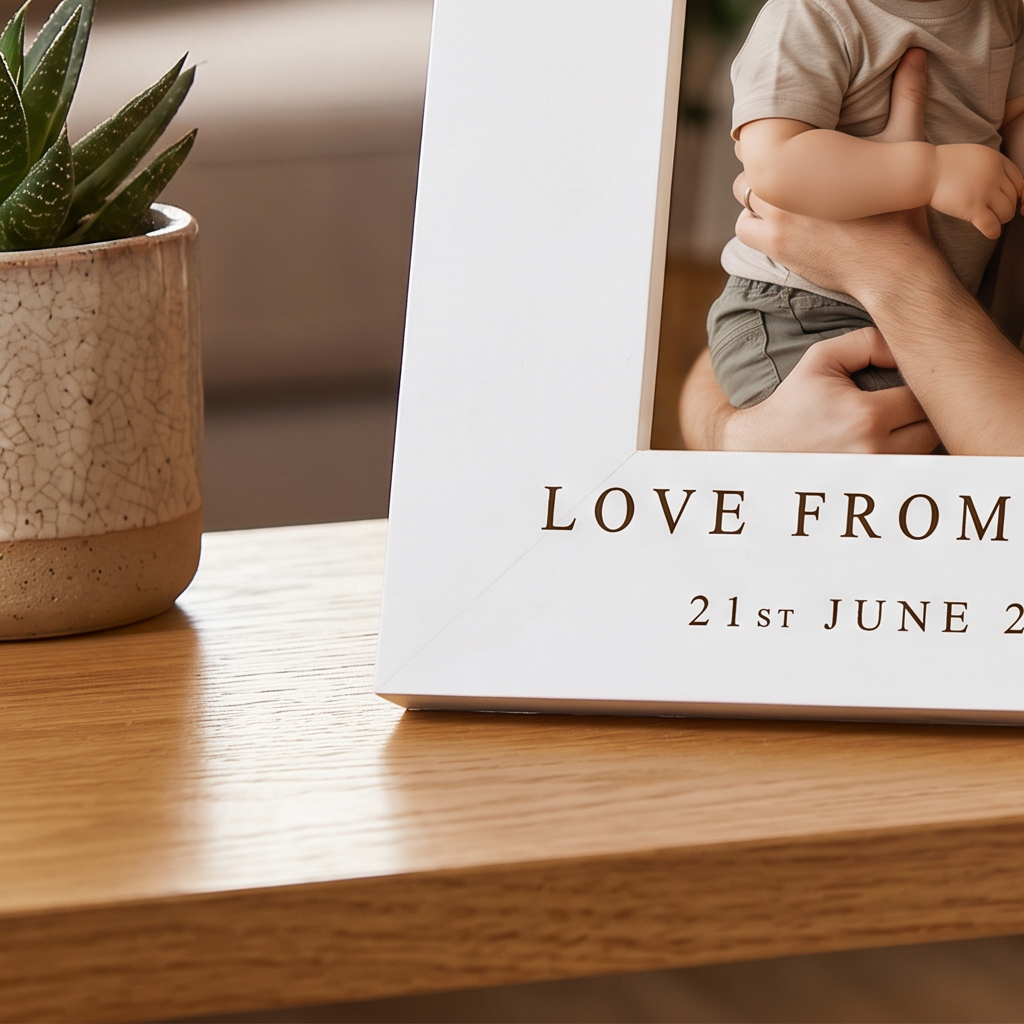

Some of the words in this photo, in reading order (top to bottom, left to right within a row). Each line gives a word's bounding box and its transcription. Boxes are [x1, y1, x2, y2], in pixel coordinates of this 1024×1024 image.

[540, 485, 747, 535] LOVE
[789, 491, 1012, 542] FROM
[823, 598, 969, 634] JUNE
